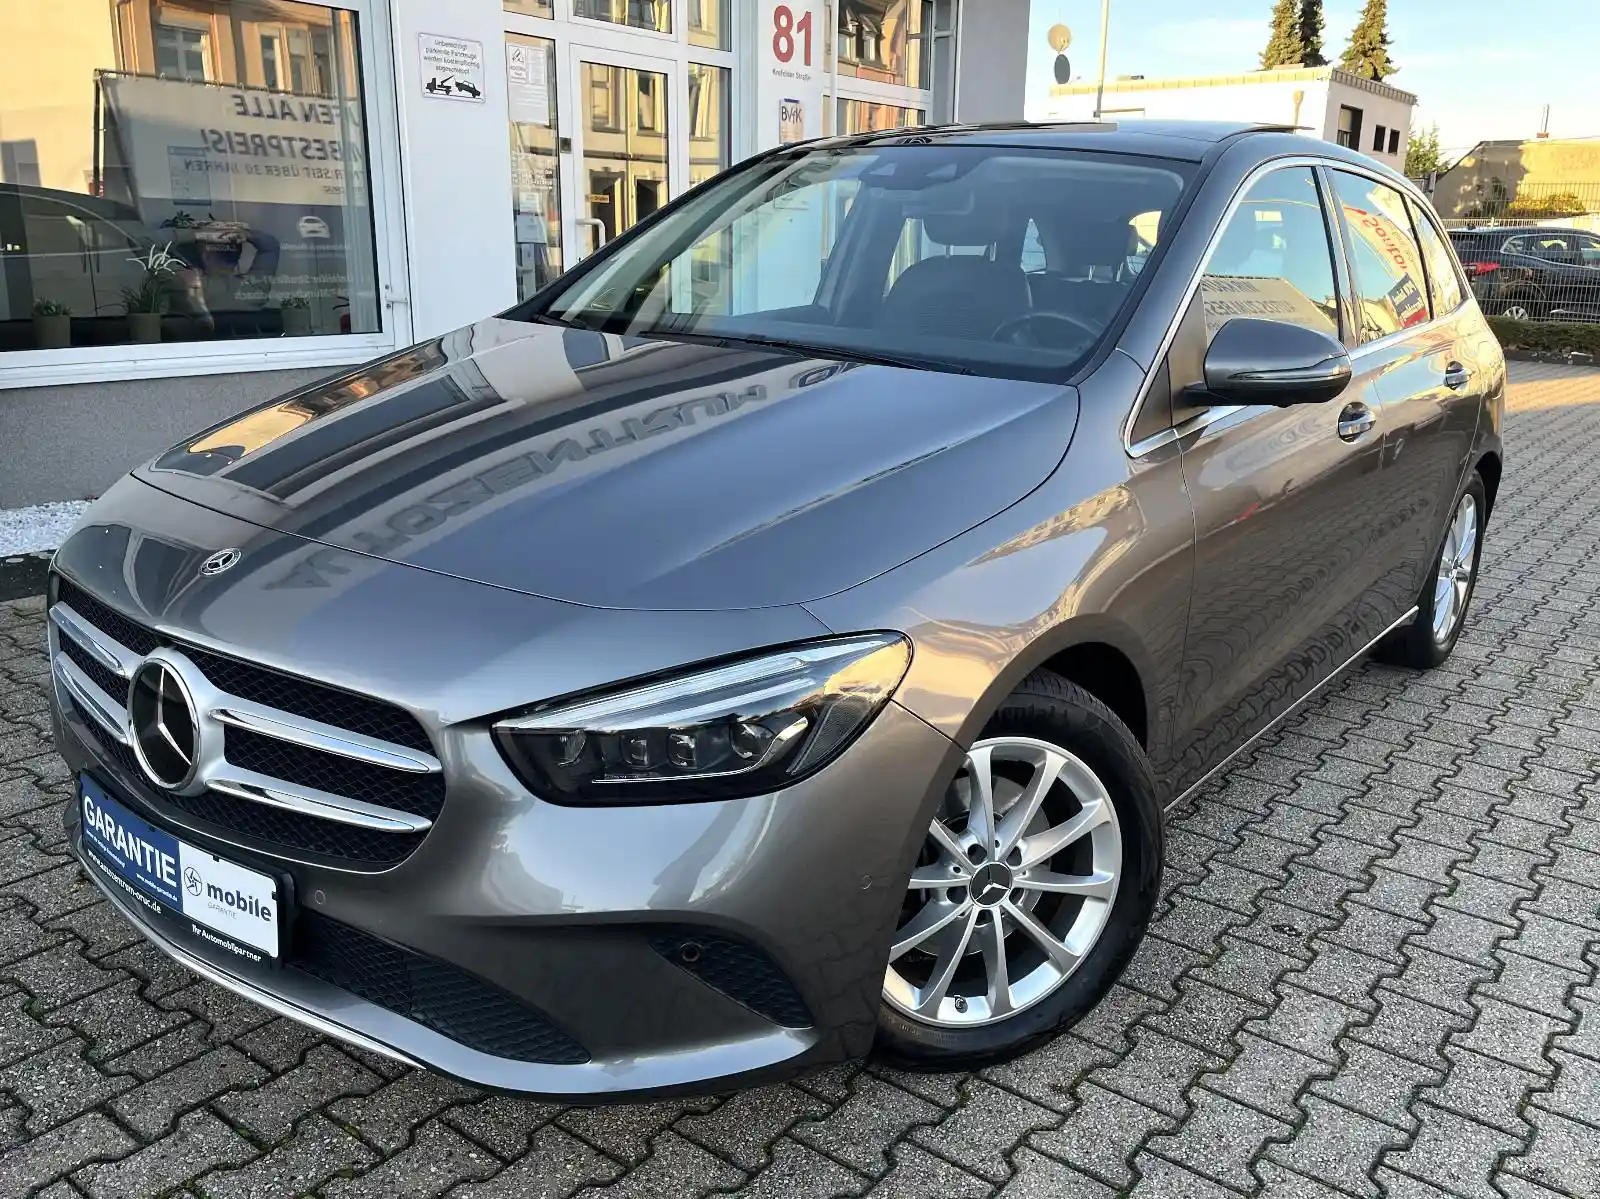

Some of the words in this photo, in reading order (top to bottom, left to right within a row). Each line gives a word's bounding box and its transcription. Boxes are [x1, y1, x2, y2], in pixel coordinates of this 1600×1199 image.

[773, 5, 811, 67] 81
[84, 795, 177, 888] GARANTIE
[207, 882, 272, 922] mobile
[202, 929, 263, 963] Automobilpartner
